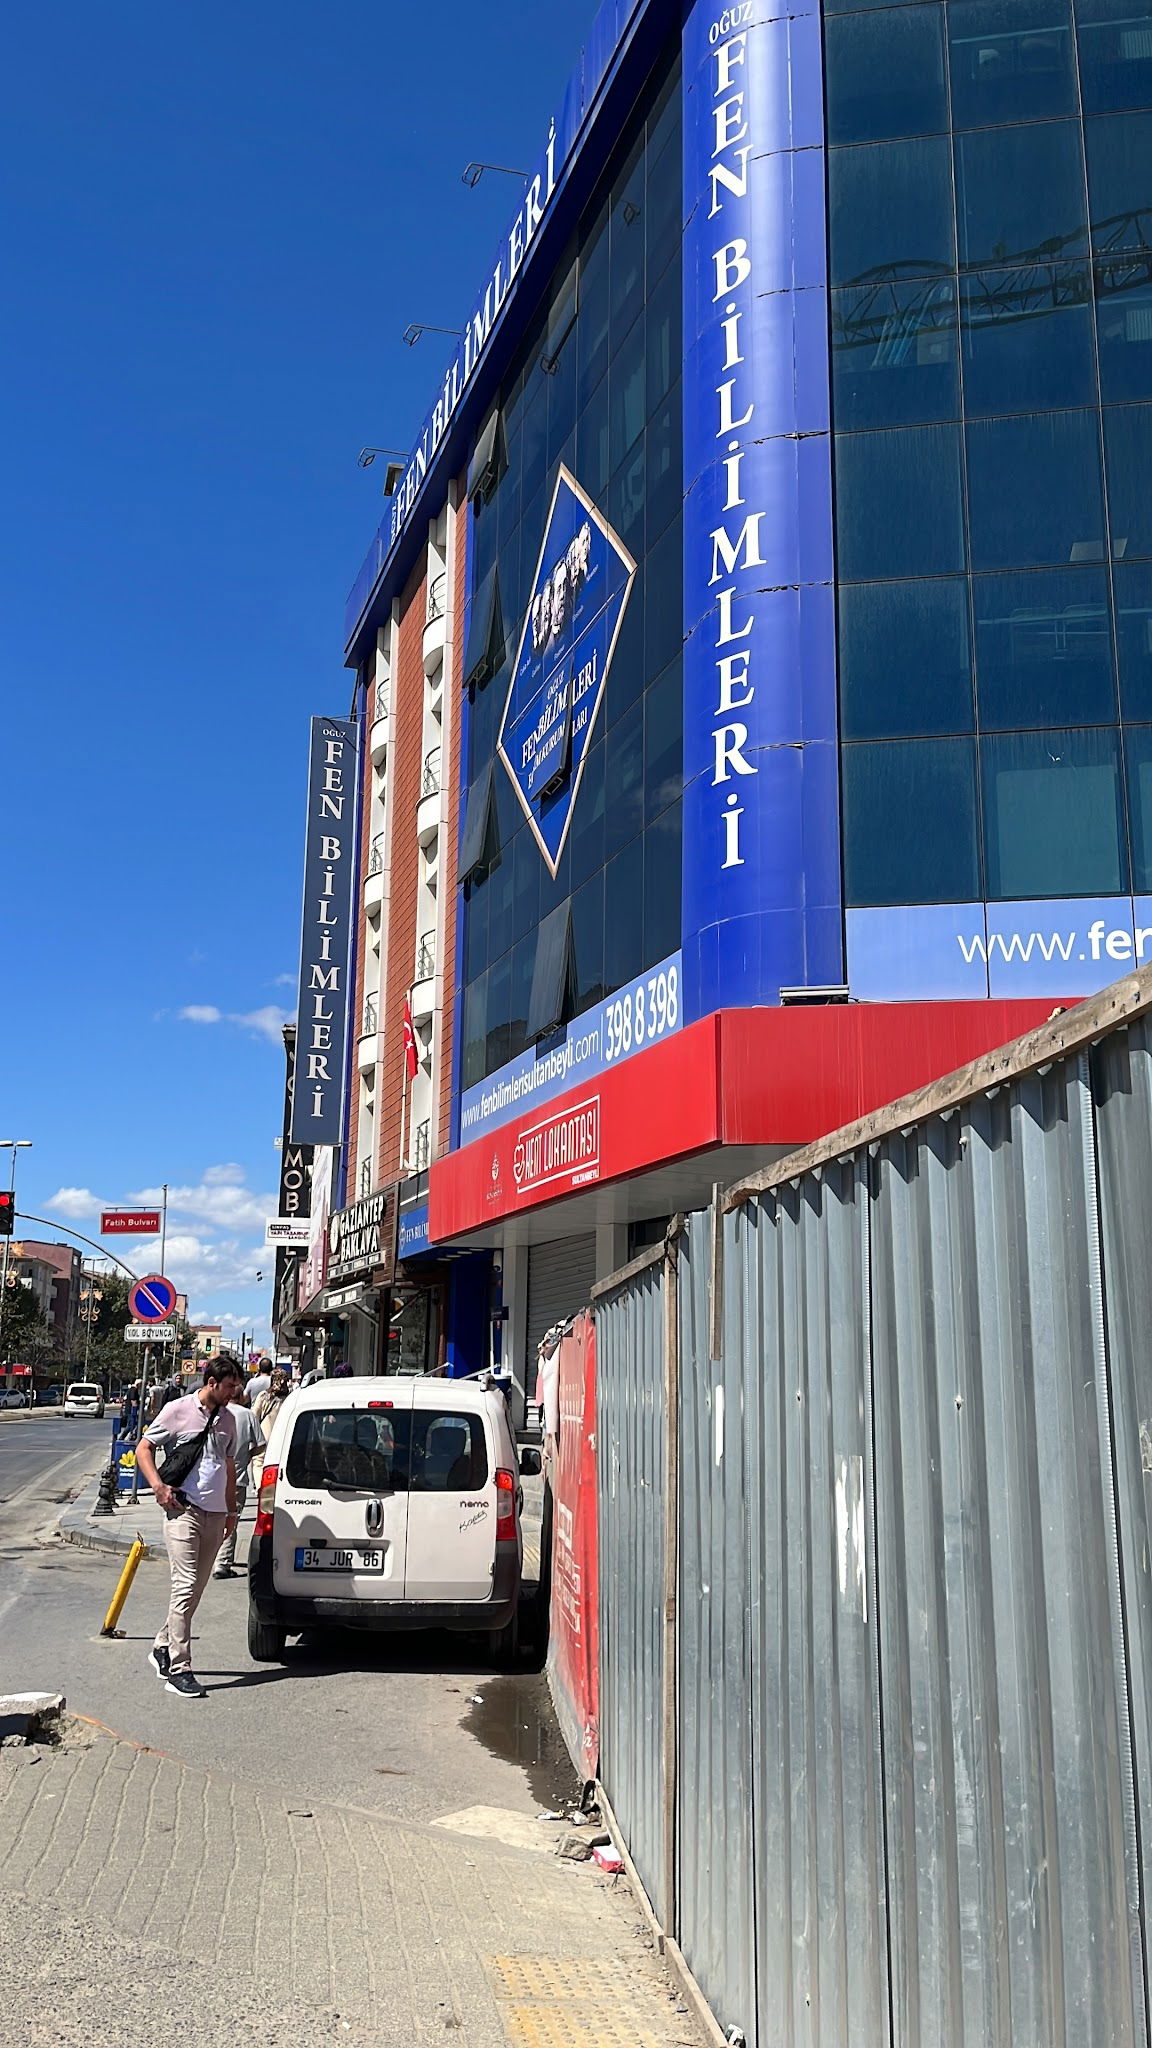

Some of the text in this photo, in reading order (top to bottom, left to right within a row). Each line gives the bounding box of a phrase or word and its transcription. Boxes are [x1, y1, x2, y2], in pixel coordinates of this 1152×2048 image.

[708, 0, 753, 44] OĞUZ
[430, 124, 557, 459] BİLİMLERİ
[707, 31, 767, 870] FEN BİLİMLERİ
[306, 739, 346, 1118] FEN BİLİMLERİ
[461, 965, 678, 1129] www.fenbilimlerisultanbeyli.com 398 8 398
[105, 1218, 157, 1227] Fatih Bulvarı
[127, 1327, 173, 1338] YOL BOYUNCA
[304, 1551, 320, 1566] 34
[329, 1551, 354, 1567] JUR
